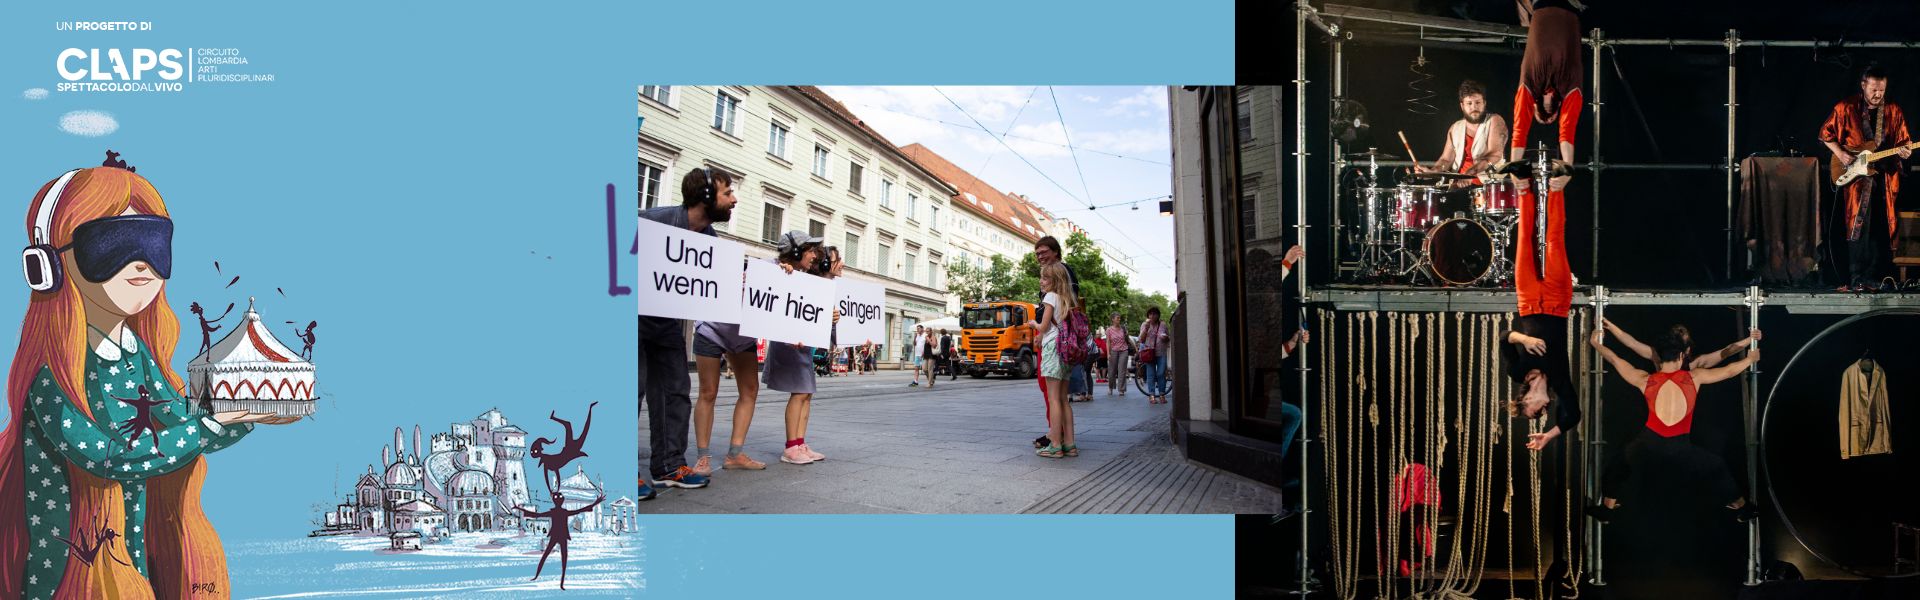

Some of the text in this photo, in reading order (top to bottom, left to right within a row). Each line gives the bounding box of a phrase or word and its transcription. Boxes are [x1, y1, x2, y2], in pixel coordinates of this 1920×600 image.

[665, 235, 713, 270] Und
[653, 271, 719, 299] wenn
[749, 286, 824, 324] wir hier
[838, 295, 881, 325] singen
